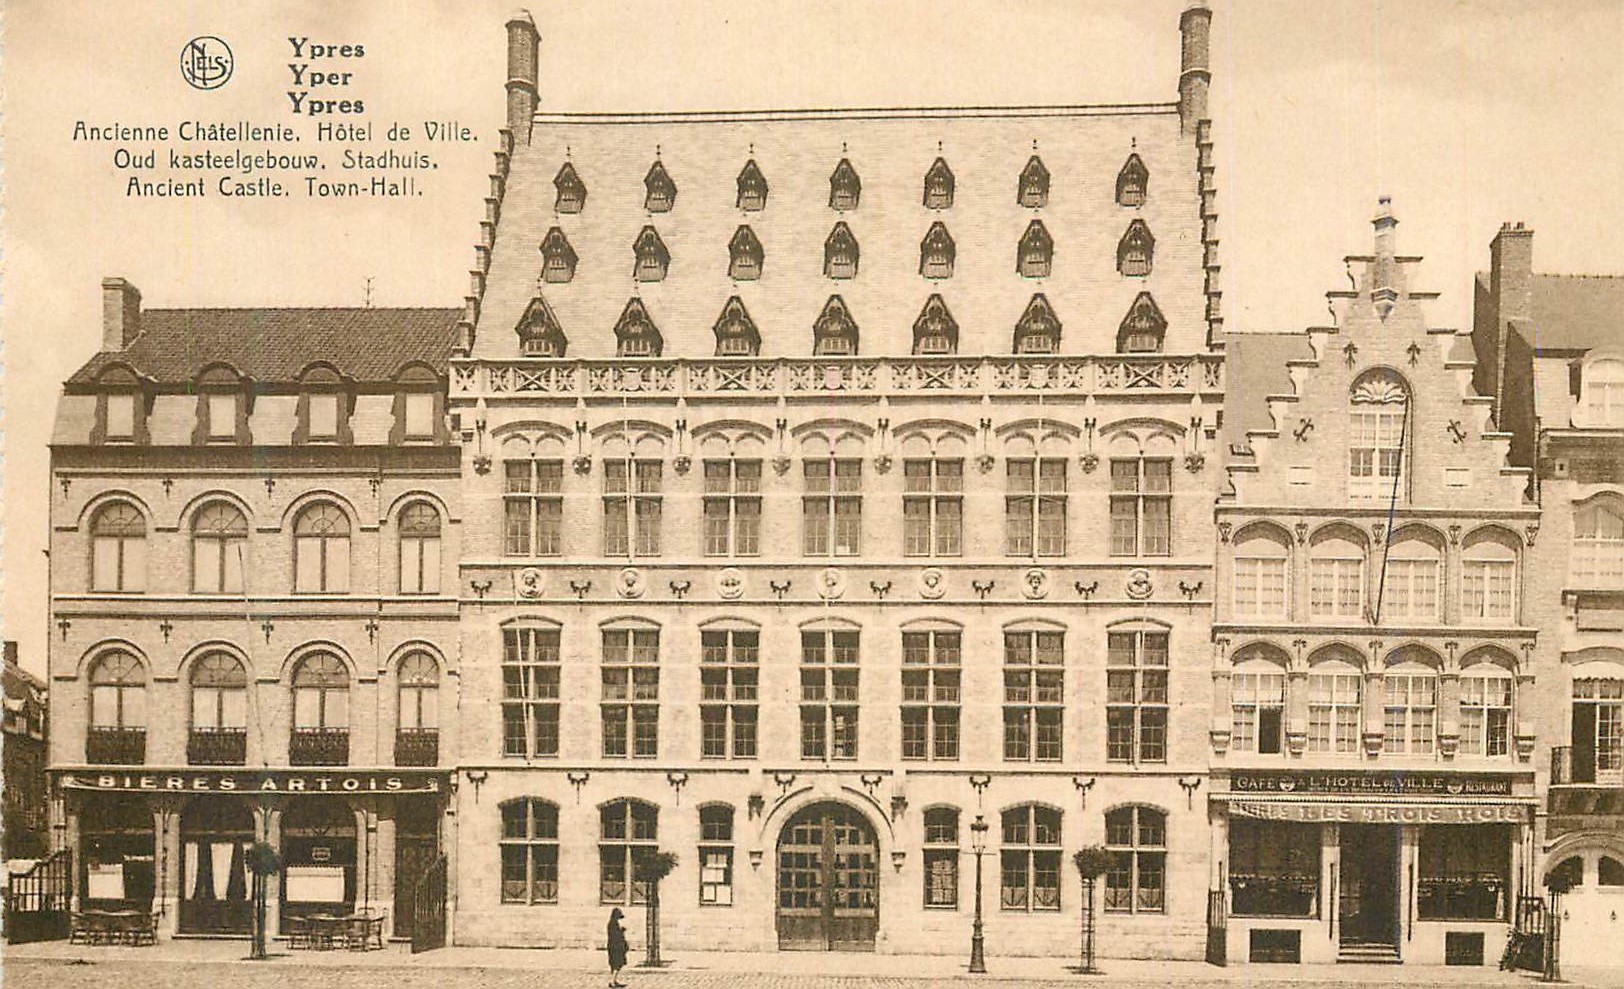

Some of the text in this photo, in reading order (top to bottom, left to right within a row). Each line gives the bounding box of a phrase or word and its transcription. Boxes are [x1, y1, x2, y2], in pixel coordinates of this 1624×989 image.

[97, 775, 403, 791] BIERES ARTOIS
[1397, 776, 1444, 788] VILLE
